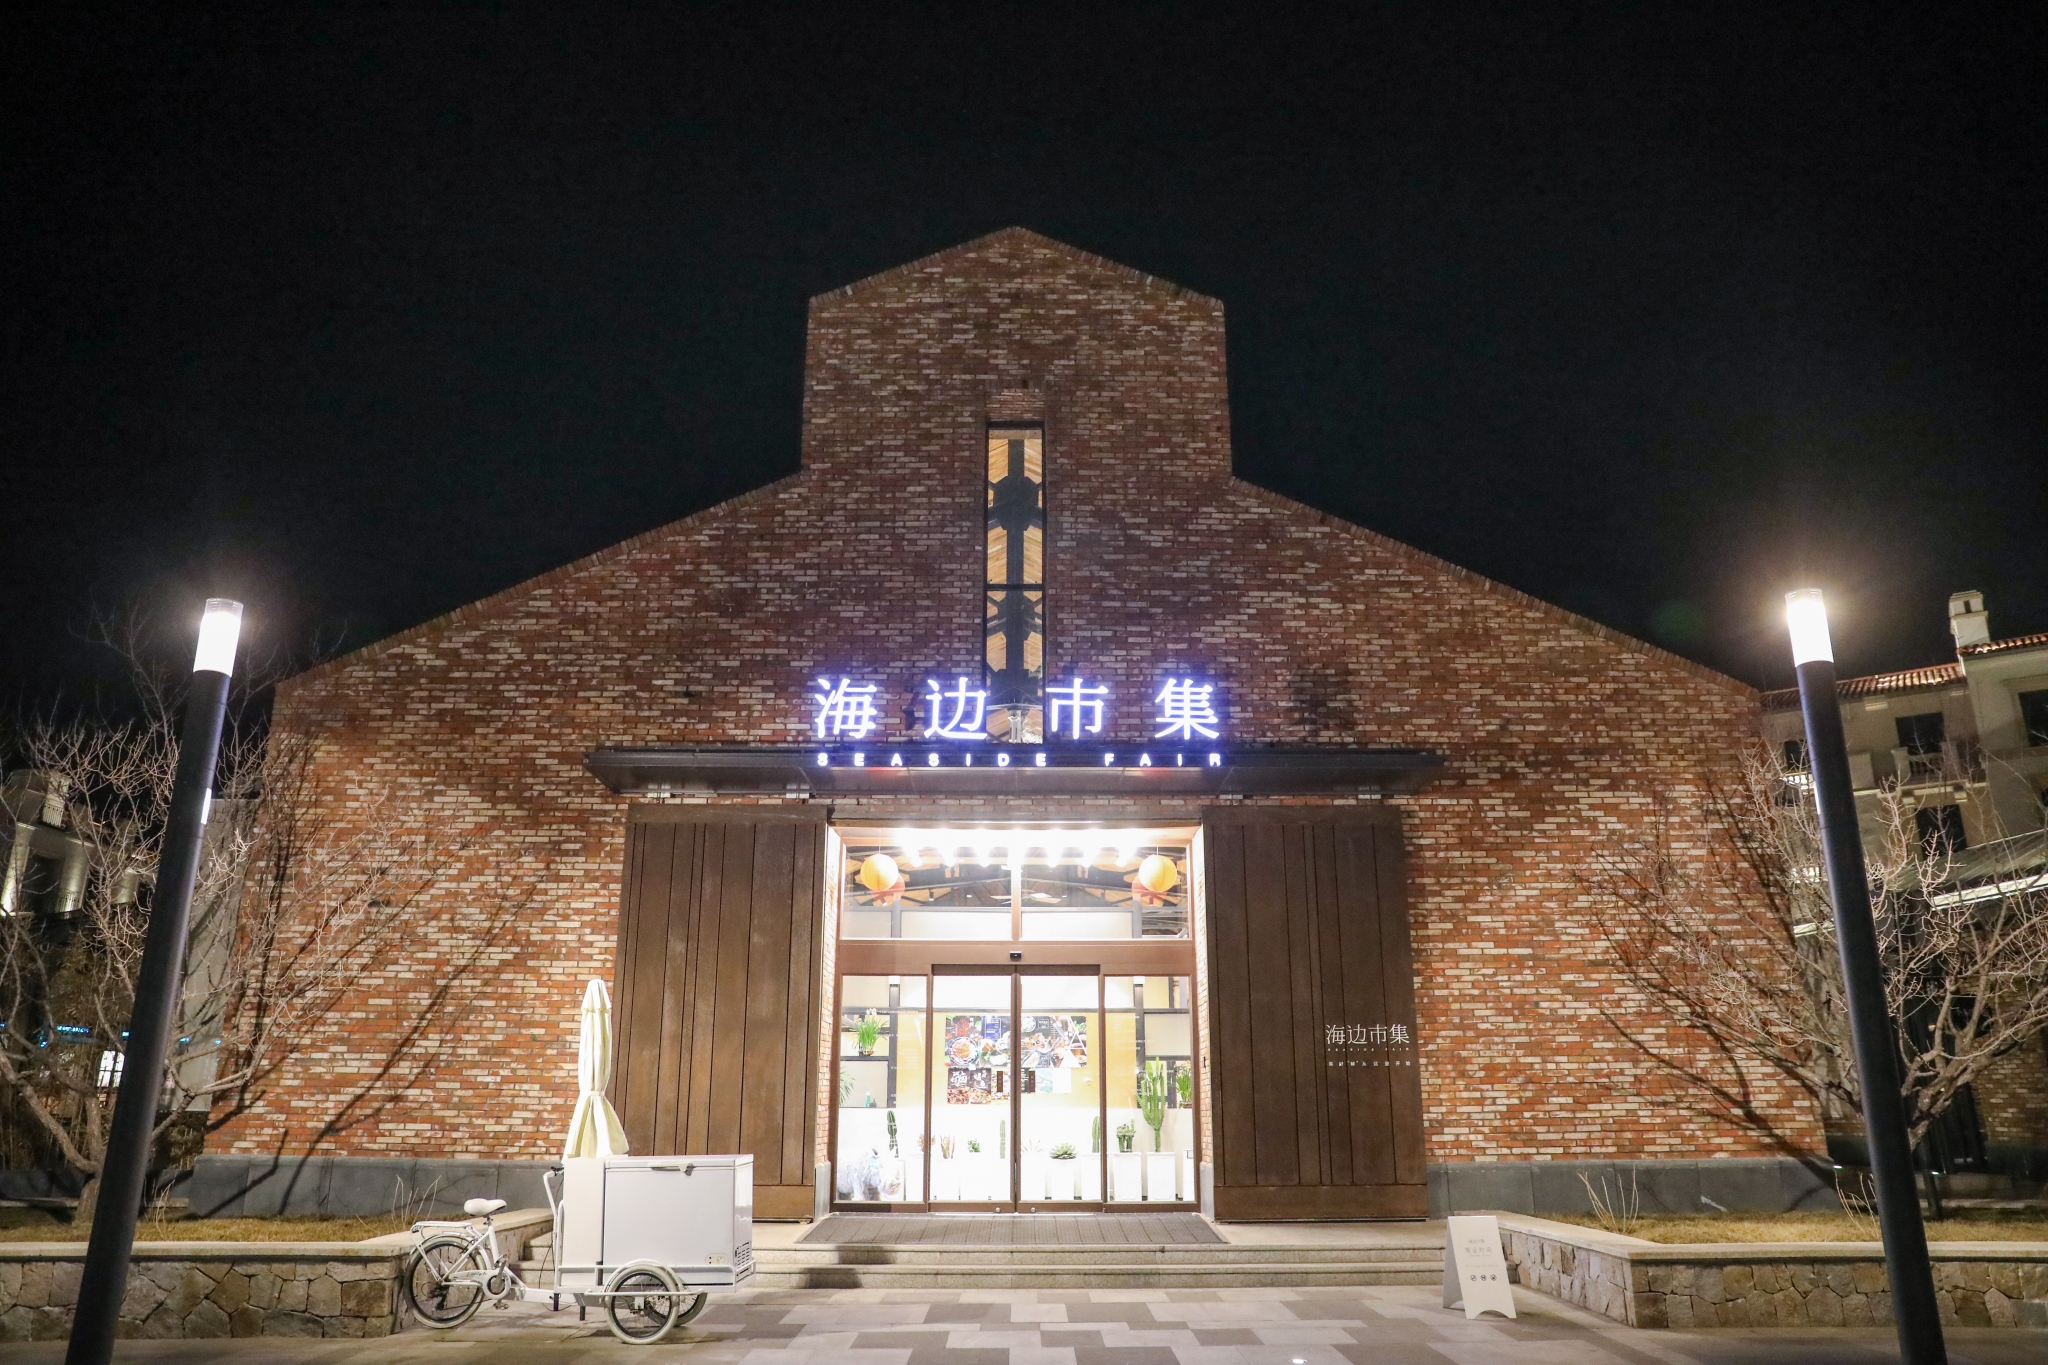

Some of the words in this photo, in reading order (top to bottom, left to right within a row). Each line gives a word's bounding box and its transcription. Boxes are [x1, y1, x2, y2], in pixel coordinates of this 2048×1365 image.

[814, 677, 1219, 740] 海边市集
[817, 753, 1047, 767] SEASIDE
[1104, 753, 1222, 767] FAIR
[1325, 1023, 1410, 1045] 海边市集
